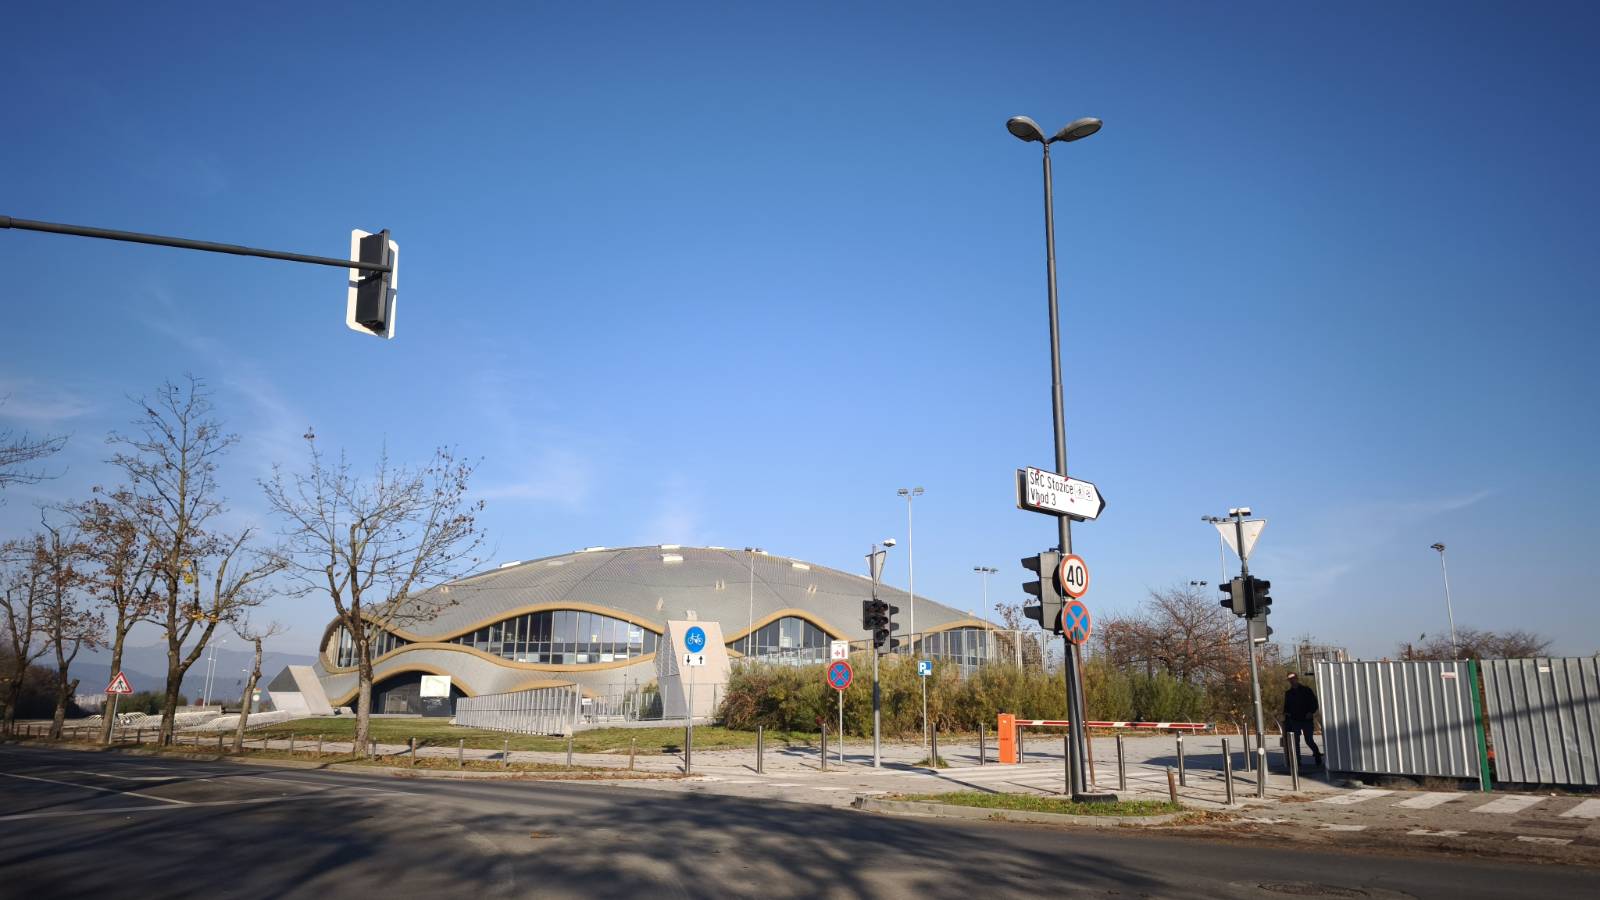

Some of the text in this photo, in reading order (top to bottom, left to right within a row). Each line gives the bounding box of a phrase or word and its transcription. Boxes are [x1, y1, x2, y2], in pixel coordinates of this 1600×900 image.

[1030, 487, 1056, 506] Vhod 3
[1067, 565, 1083, 587] 40
[919, 662, 927, 673] P
